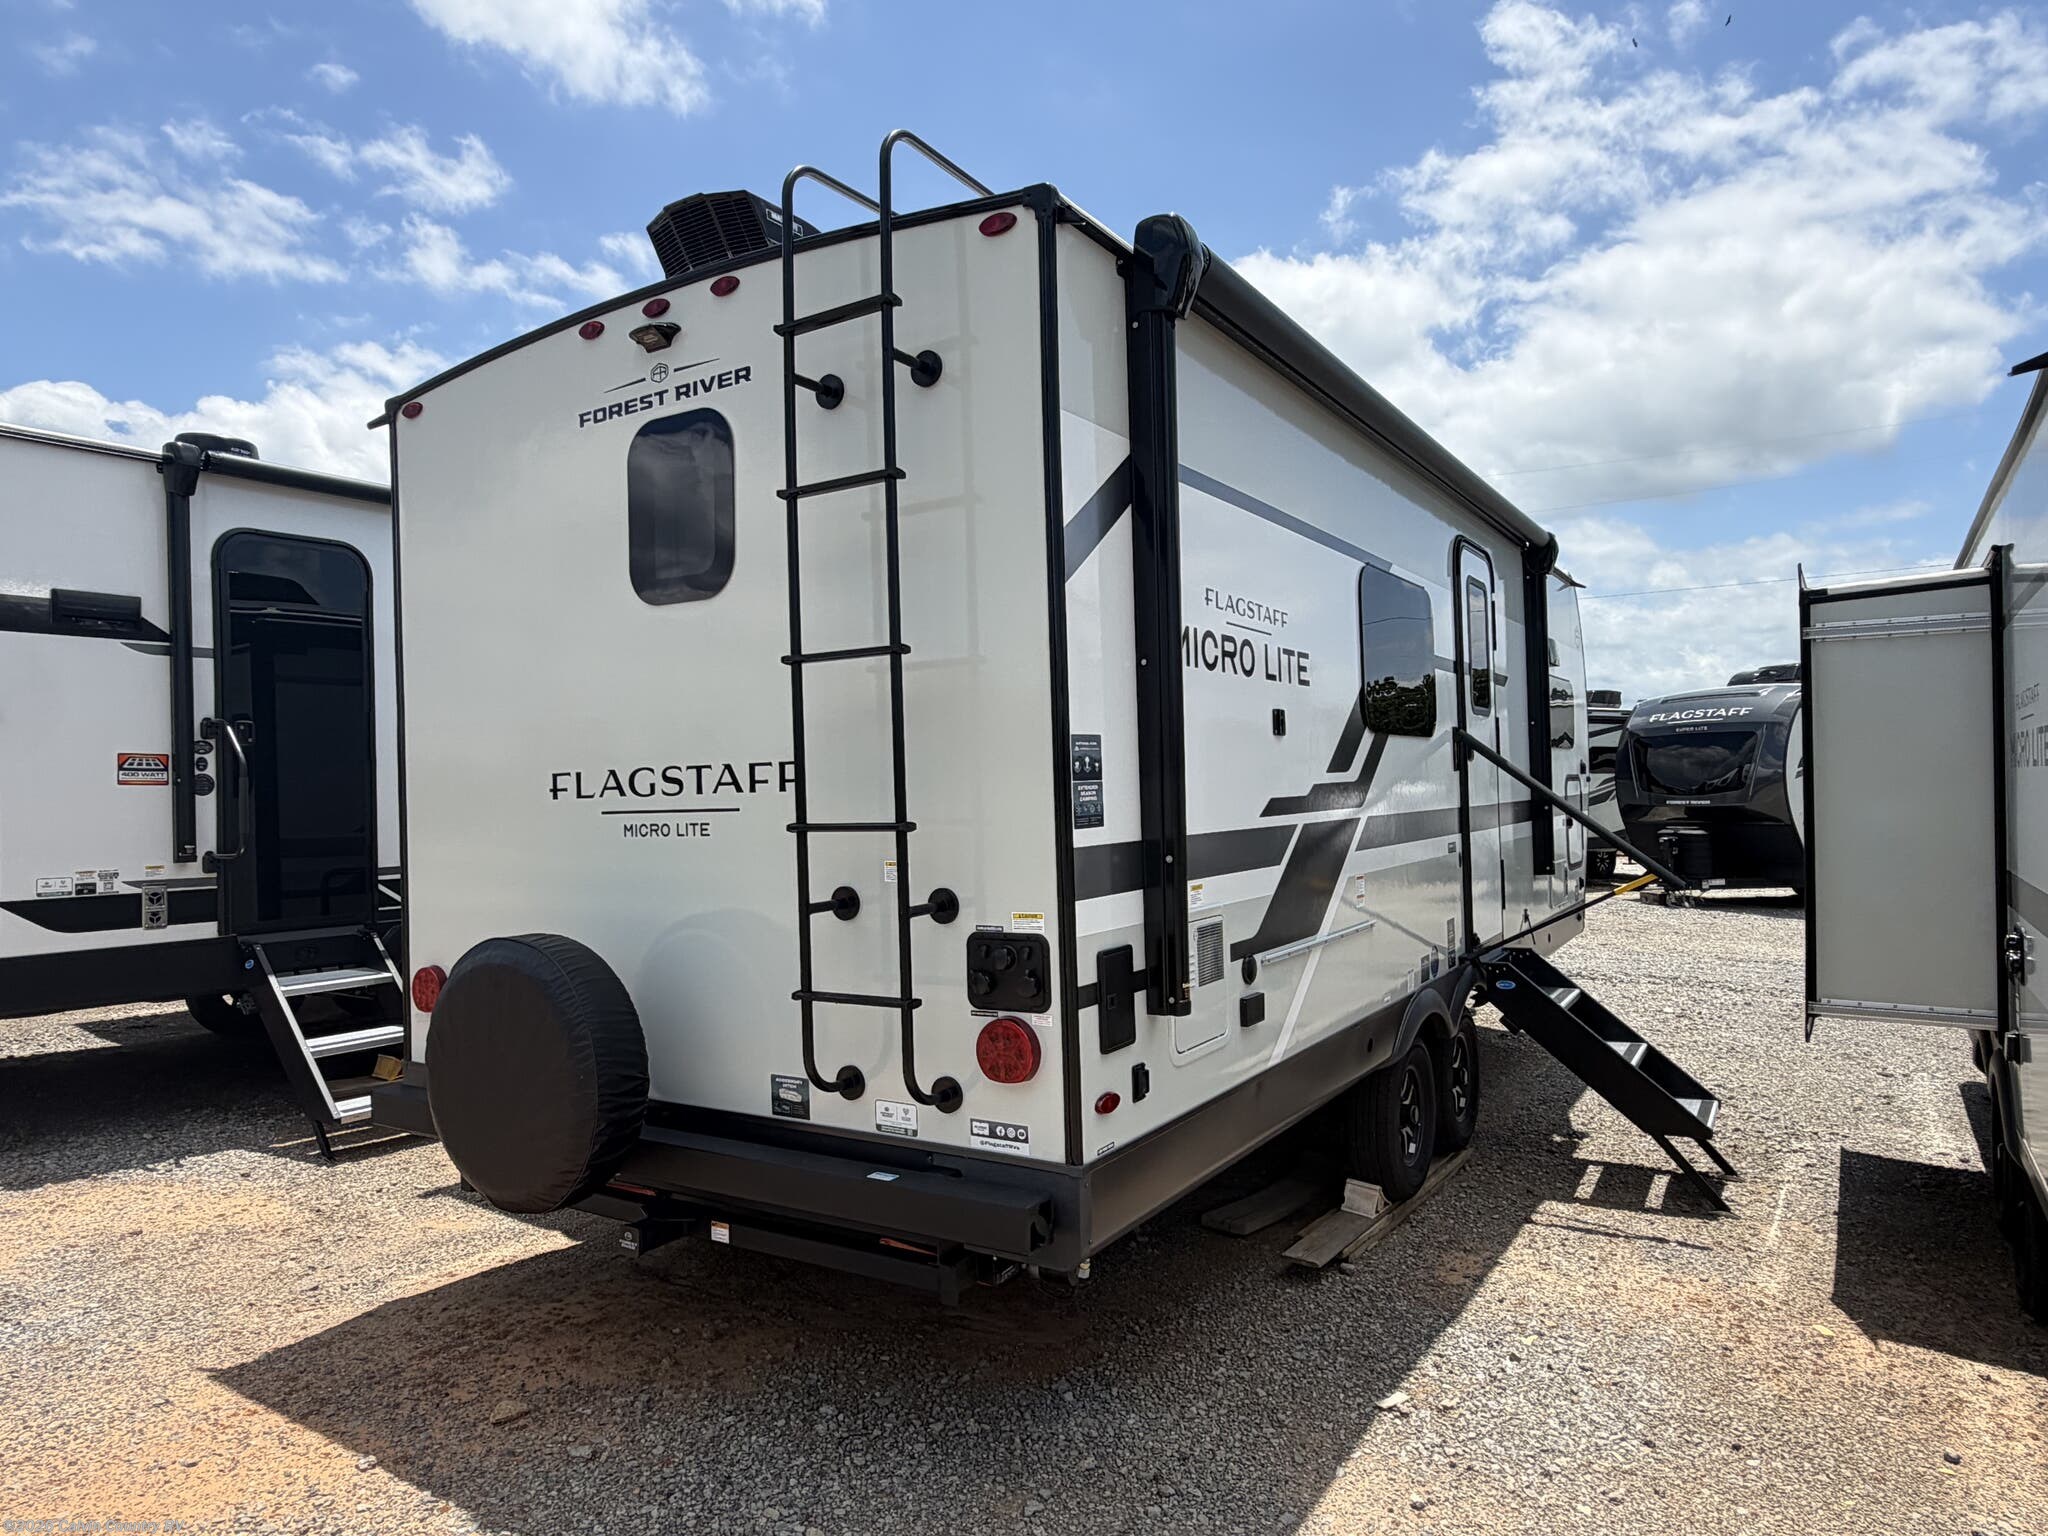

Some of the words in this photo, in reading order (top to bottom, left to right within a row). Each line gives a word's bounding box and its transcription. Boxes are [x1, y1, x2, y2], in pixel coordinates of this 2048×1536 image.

[578, 389, 669, 428] FOREST
[674, 366, 752, 401] RIVER
[1204, 587, 1288, 628] FLAGSTAFF
[1264, 643, 1310, 687] LITE
[1649, 707, 1754, 722] FLAGSTAFF
[623, 823, 671, 838] MICRO
[676, 822, 710, 837] LITE
